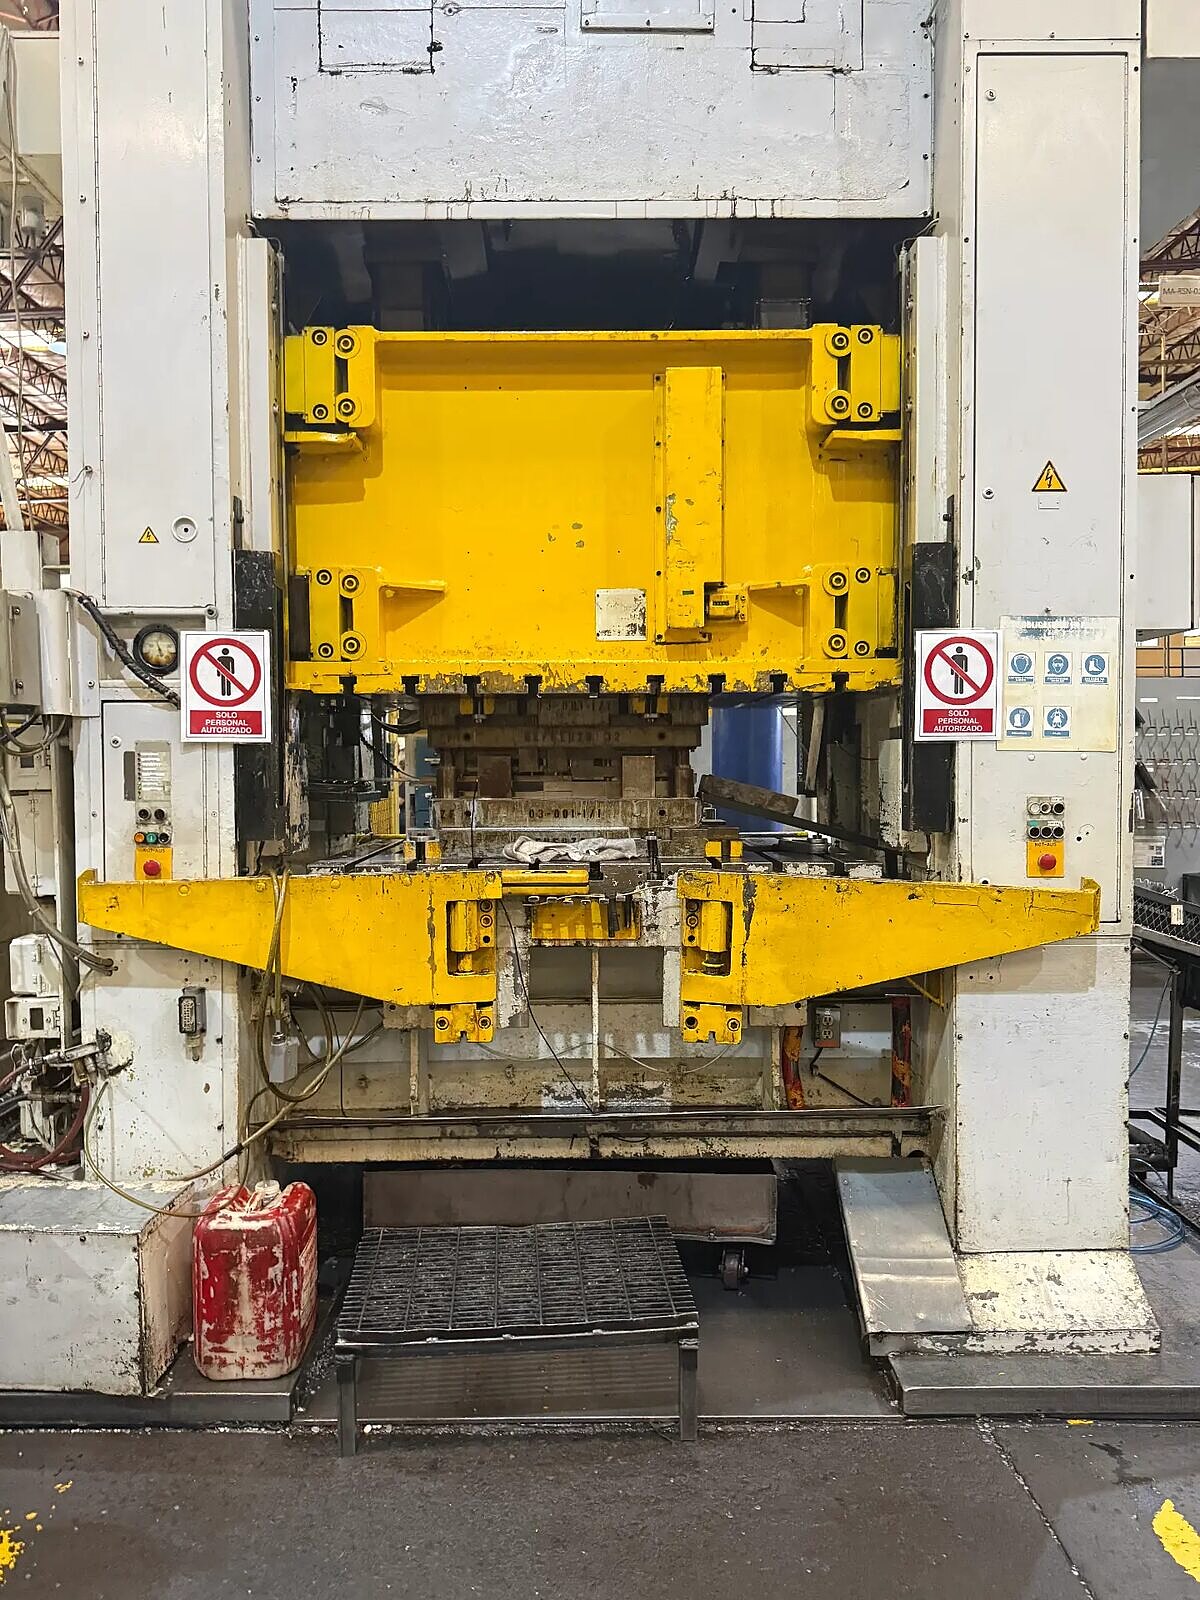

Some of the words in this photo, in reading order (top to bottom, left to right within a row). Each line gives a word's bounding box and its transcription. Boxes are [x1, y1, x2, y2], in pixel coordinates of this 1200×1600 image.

[215, 711, 238, 719] SOLO
[947, 709, 969, 717] SOLO
[937, 717, 980, 725] PERSONAL
[200, 726, 252, 734] AUTORIZADO
